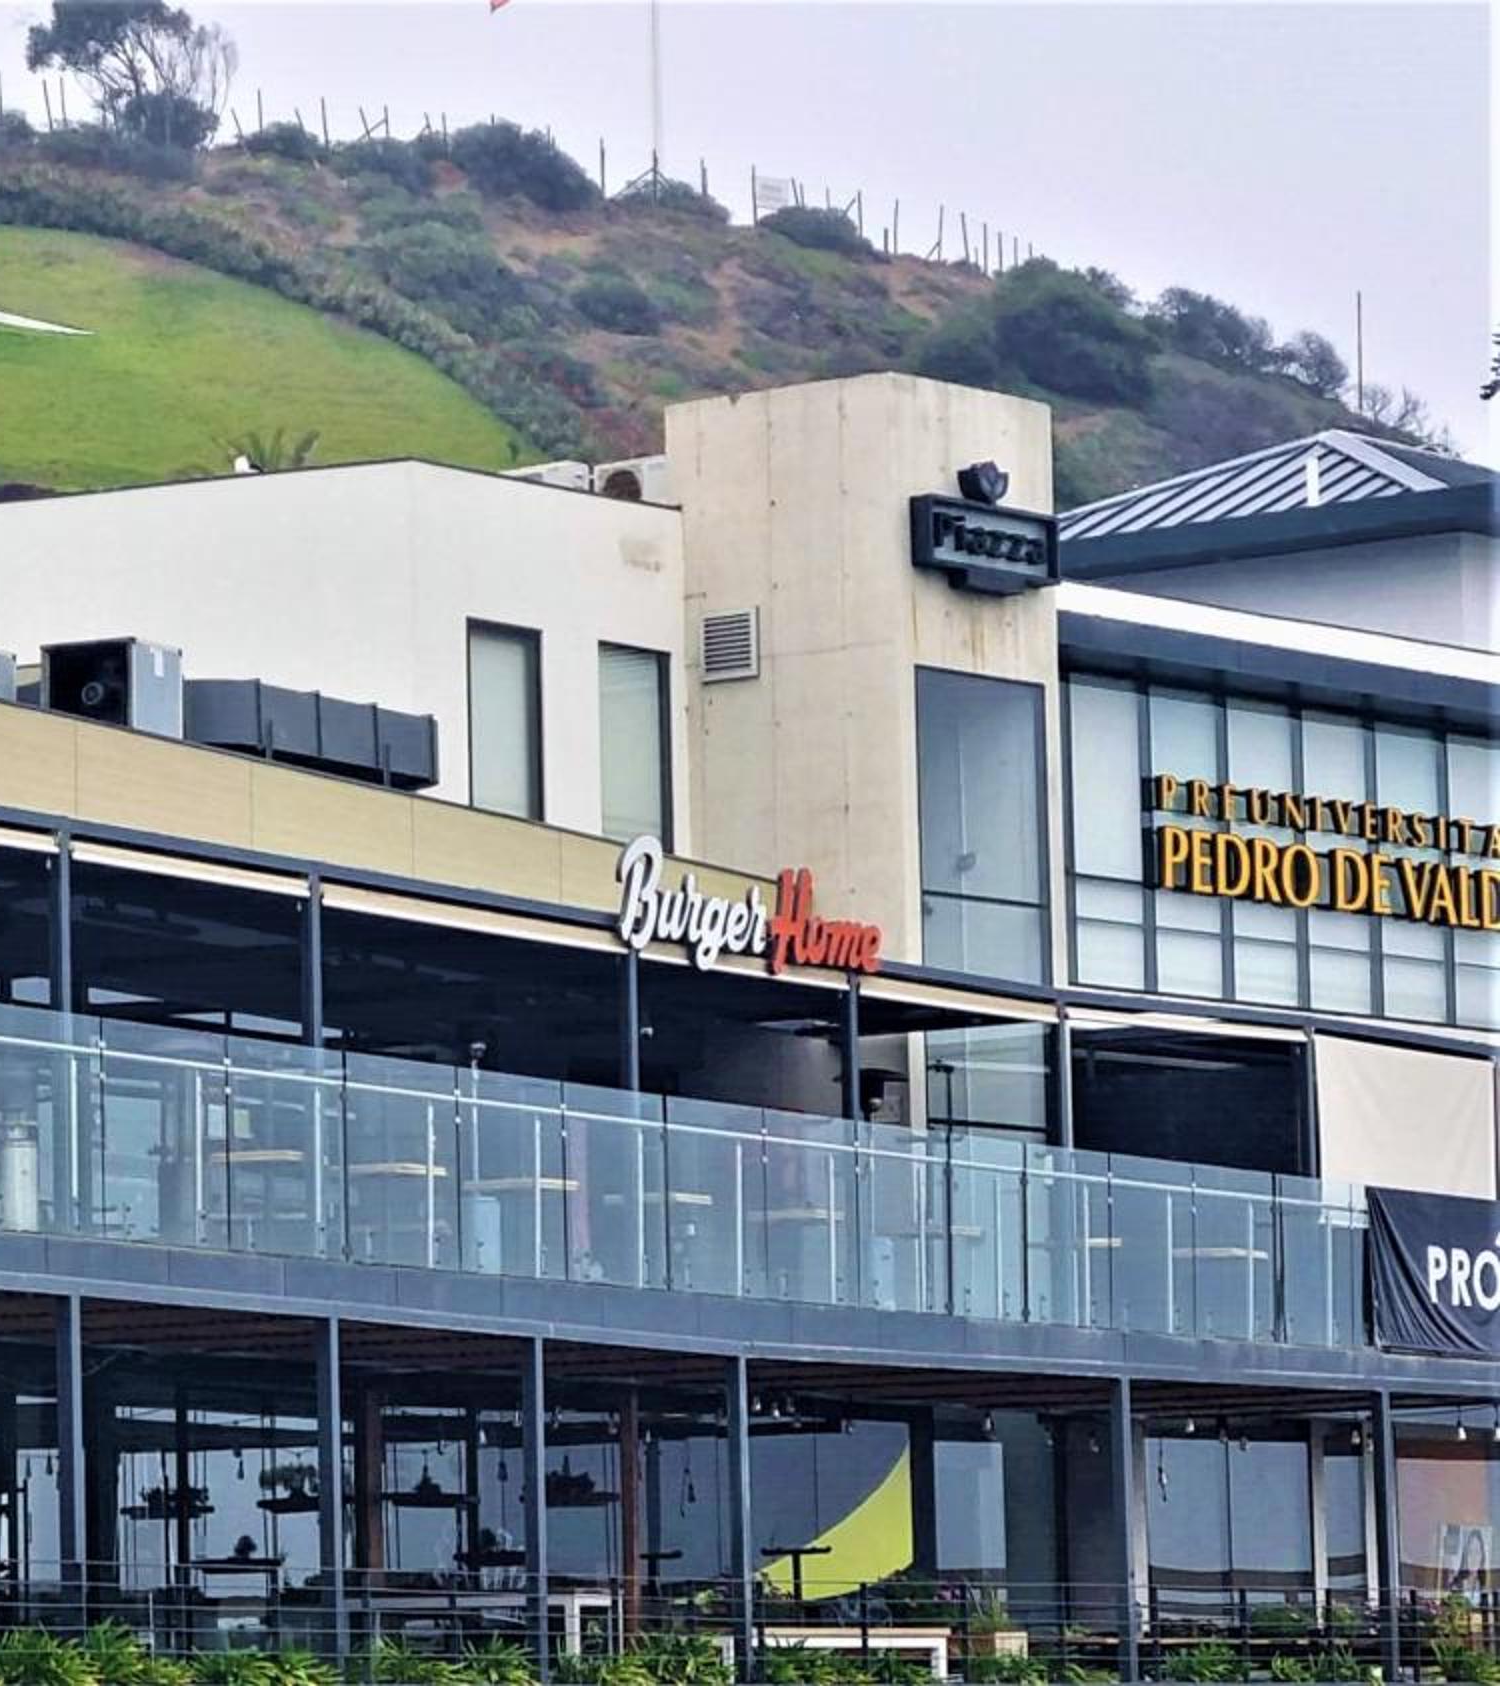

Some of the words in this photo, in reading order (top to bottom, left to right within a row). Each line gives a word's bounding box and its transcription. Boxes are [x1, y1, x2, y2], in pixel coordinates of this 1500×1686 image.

[932, 511, 1046, 565] Piazza
[618, 835, 768, 971] Burger
[770, 867, 884, 975] Home
[1158, 825, 1320, 908] PEDRO
[1333, 847, 1394, 915] DE
[1401, 857, 1500, 931] VALD
